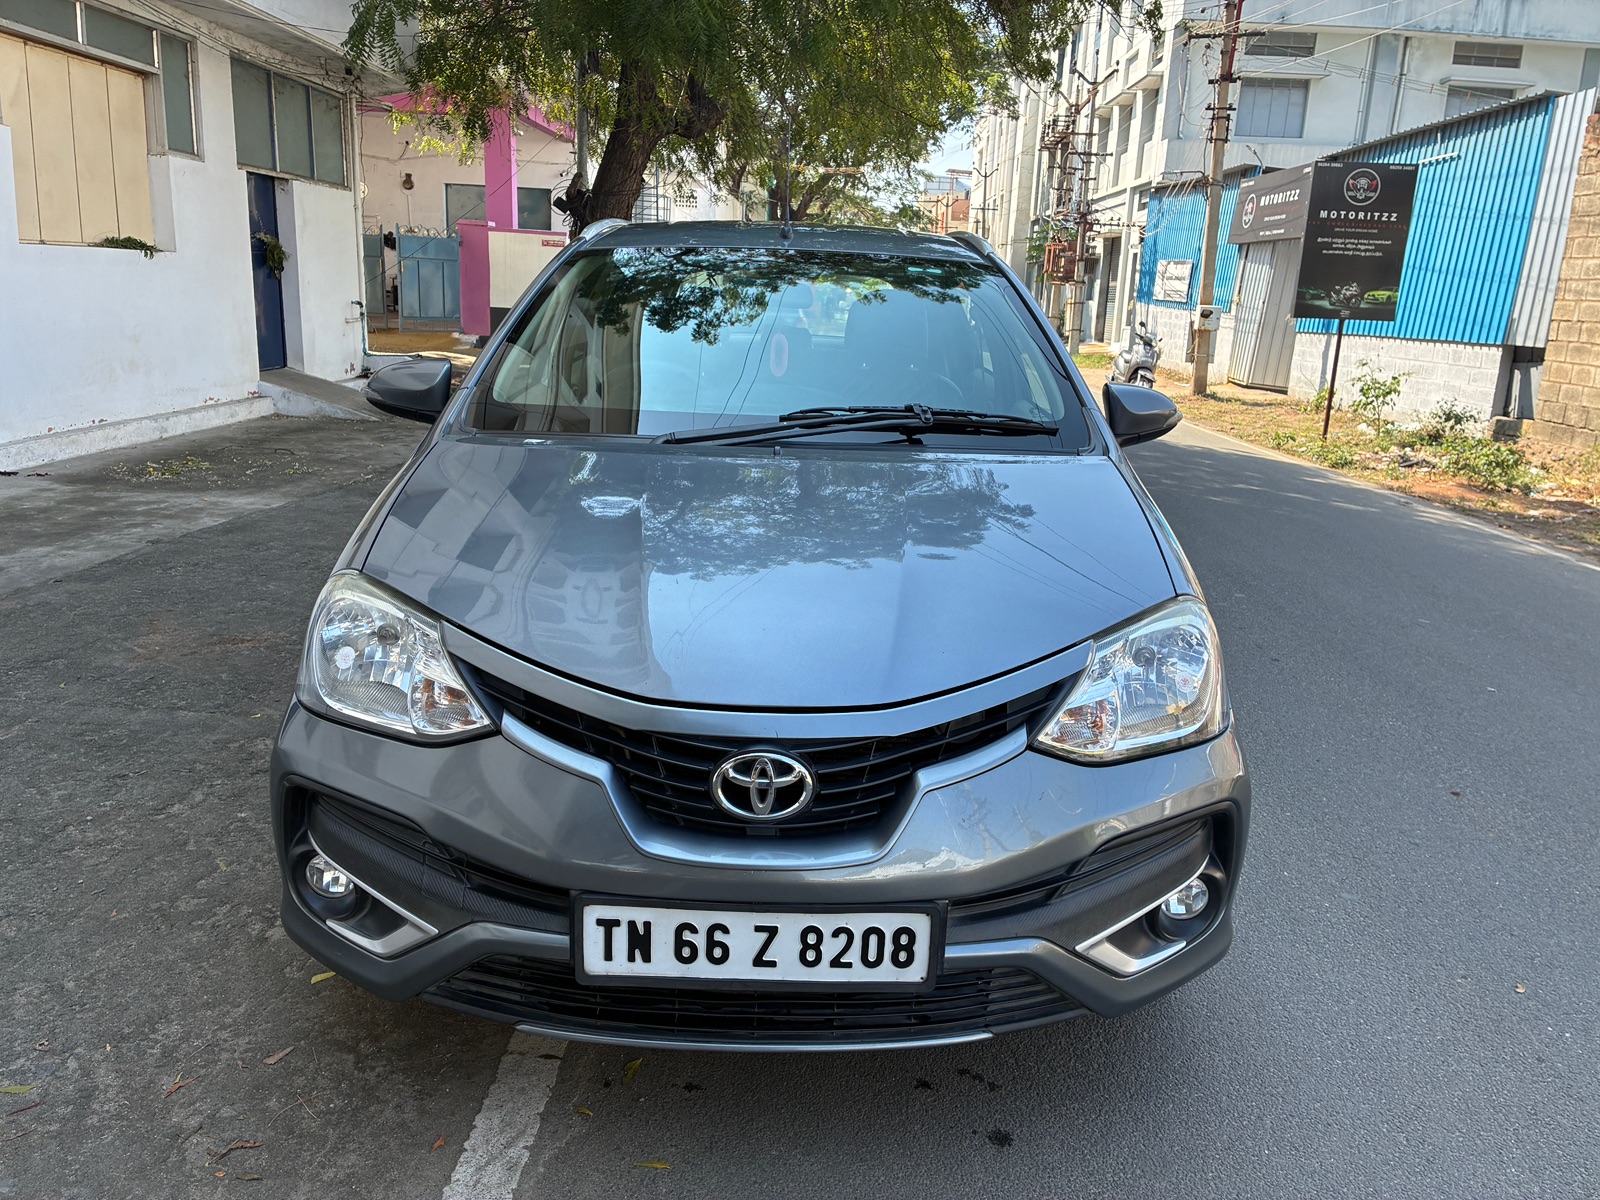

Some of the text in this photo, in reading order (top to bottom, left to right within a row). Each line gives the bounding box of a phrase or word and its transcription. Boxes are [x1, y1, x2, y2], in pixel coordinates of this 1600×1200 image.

[1260, 189, 1300, 207] MOTORITZZ
[1319, 210, 1398, 221] MOTORITZZ
[595, 918, 917, 969] TN 66 Z 8208
